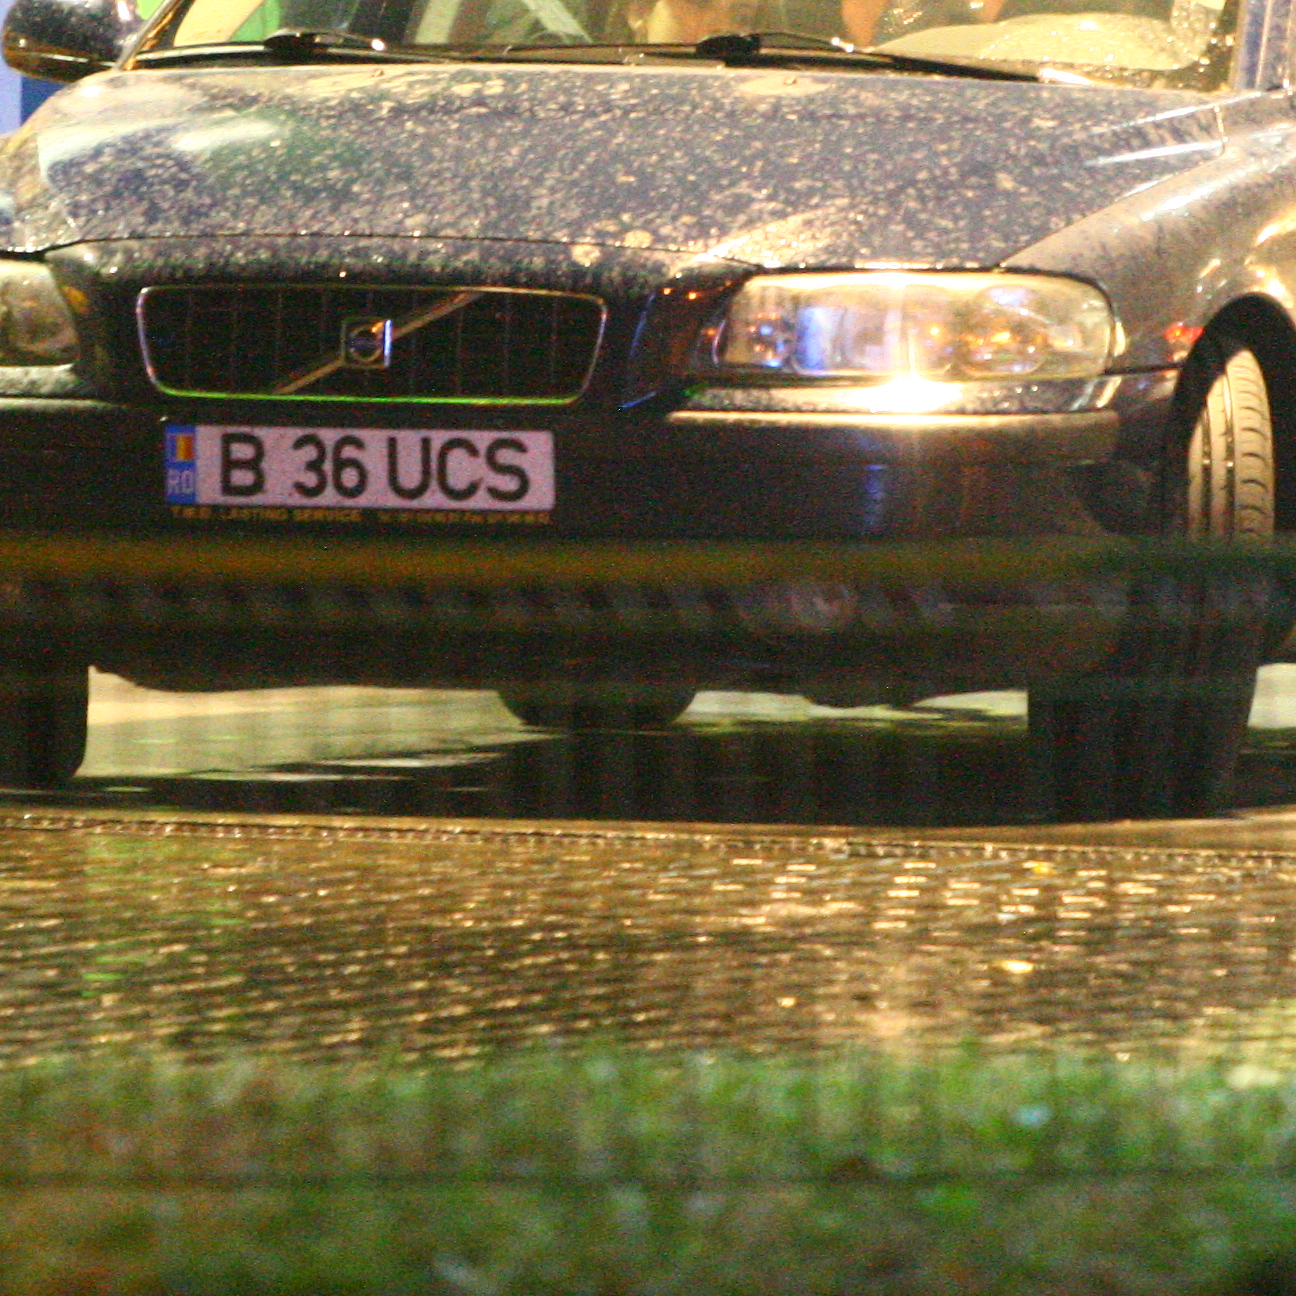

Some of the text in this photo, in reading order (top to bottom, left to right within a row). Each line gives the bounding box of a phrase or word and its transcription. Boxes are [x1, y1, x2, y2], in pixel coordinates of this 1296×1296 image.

[167, 468, 194, 494] RO
[219, 433, 532, 503] B 36 UCS
